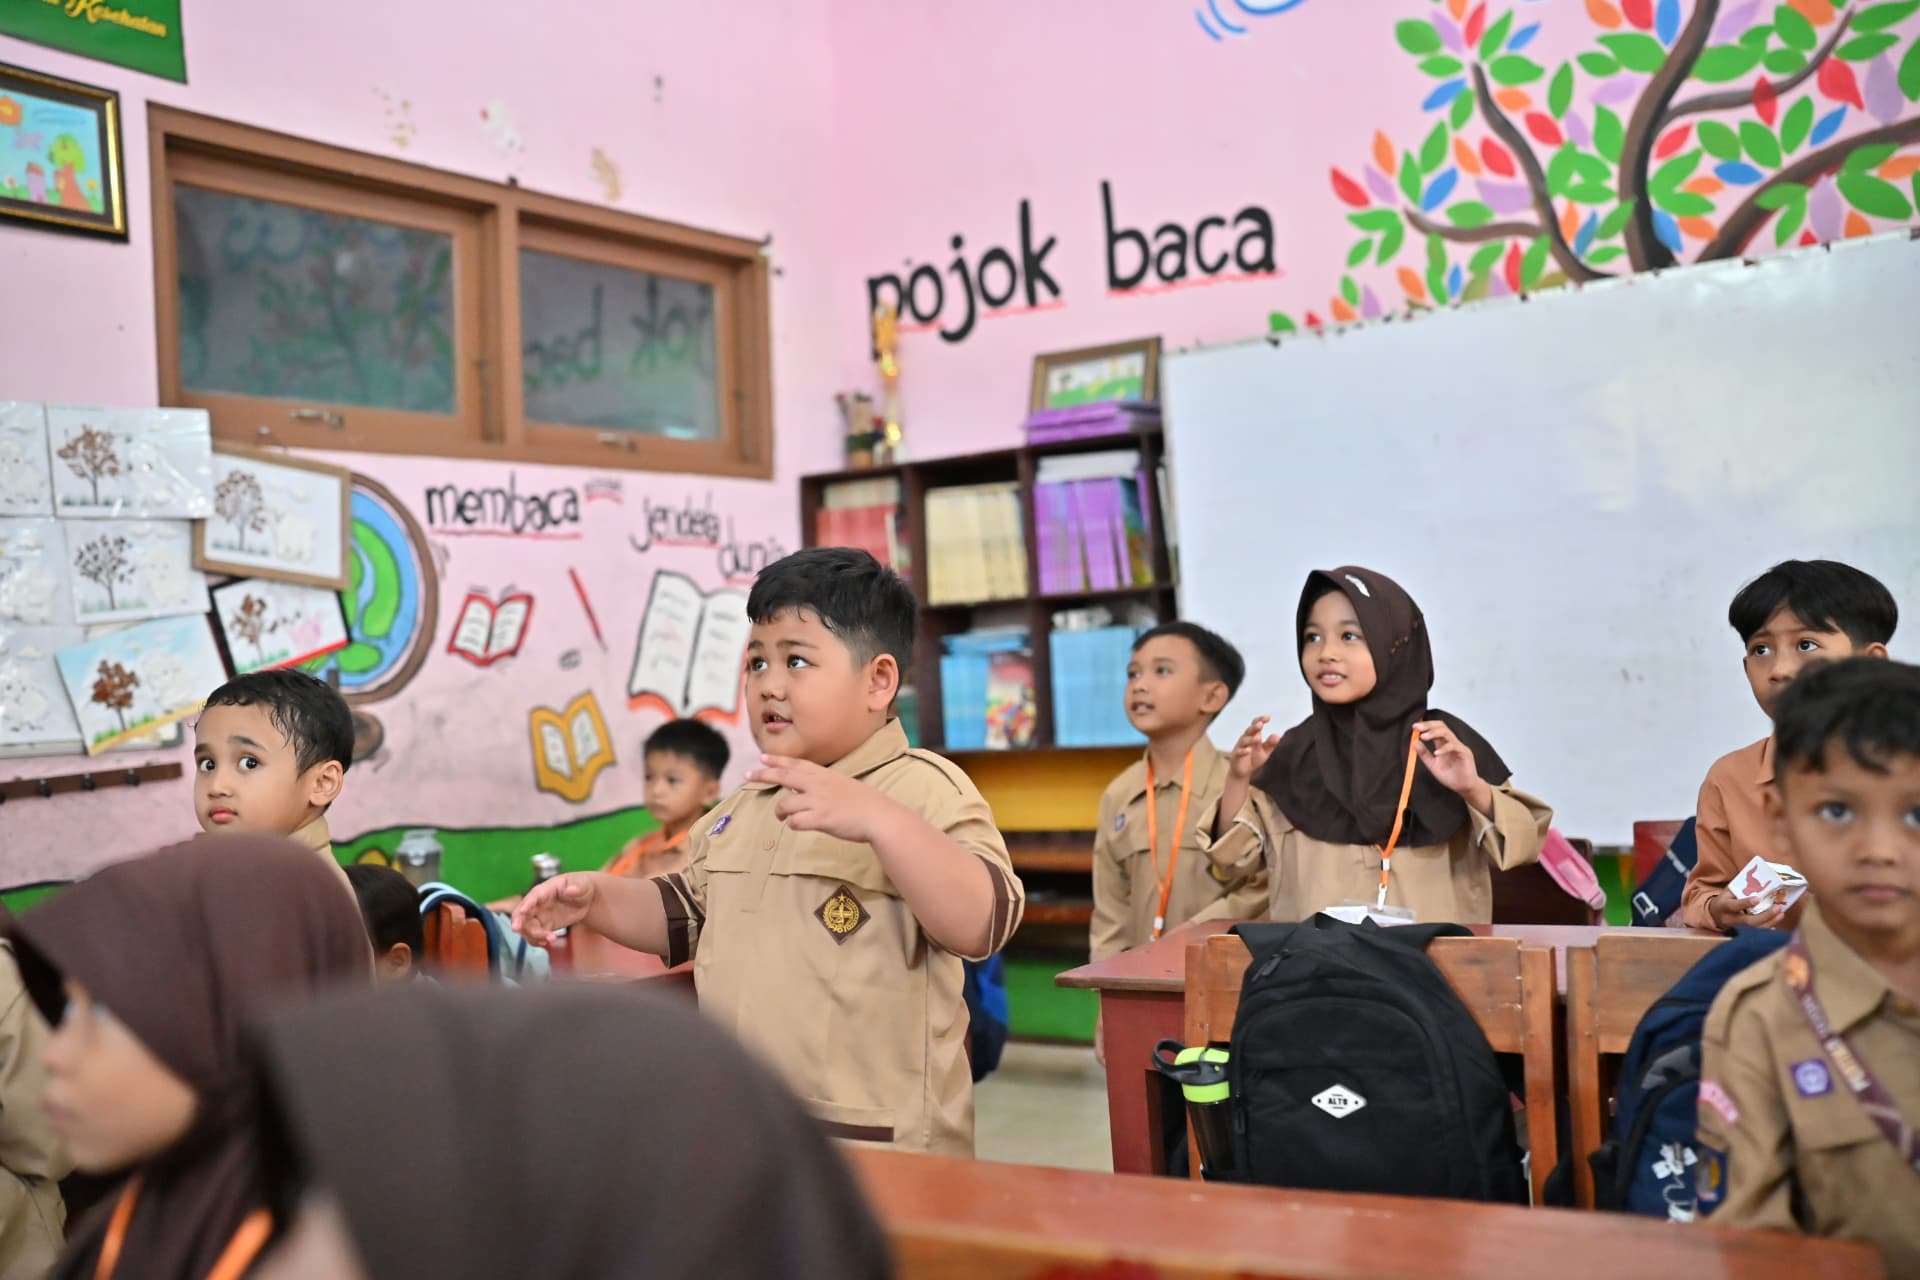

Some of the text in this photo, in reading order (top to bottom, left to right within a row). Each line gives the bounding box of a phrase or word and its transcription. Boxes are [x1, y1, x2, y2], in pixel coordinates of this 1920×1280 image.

[867, 180, 1277, 361] pojok baca
[426, 472, 579, 533] membaca
